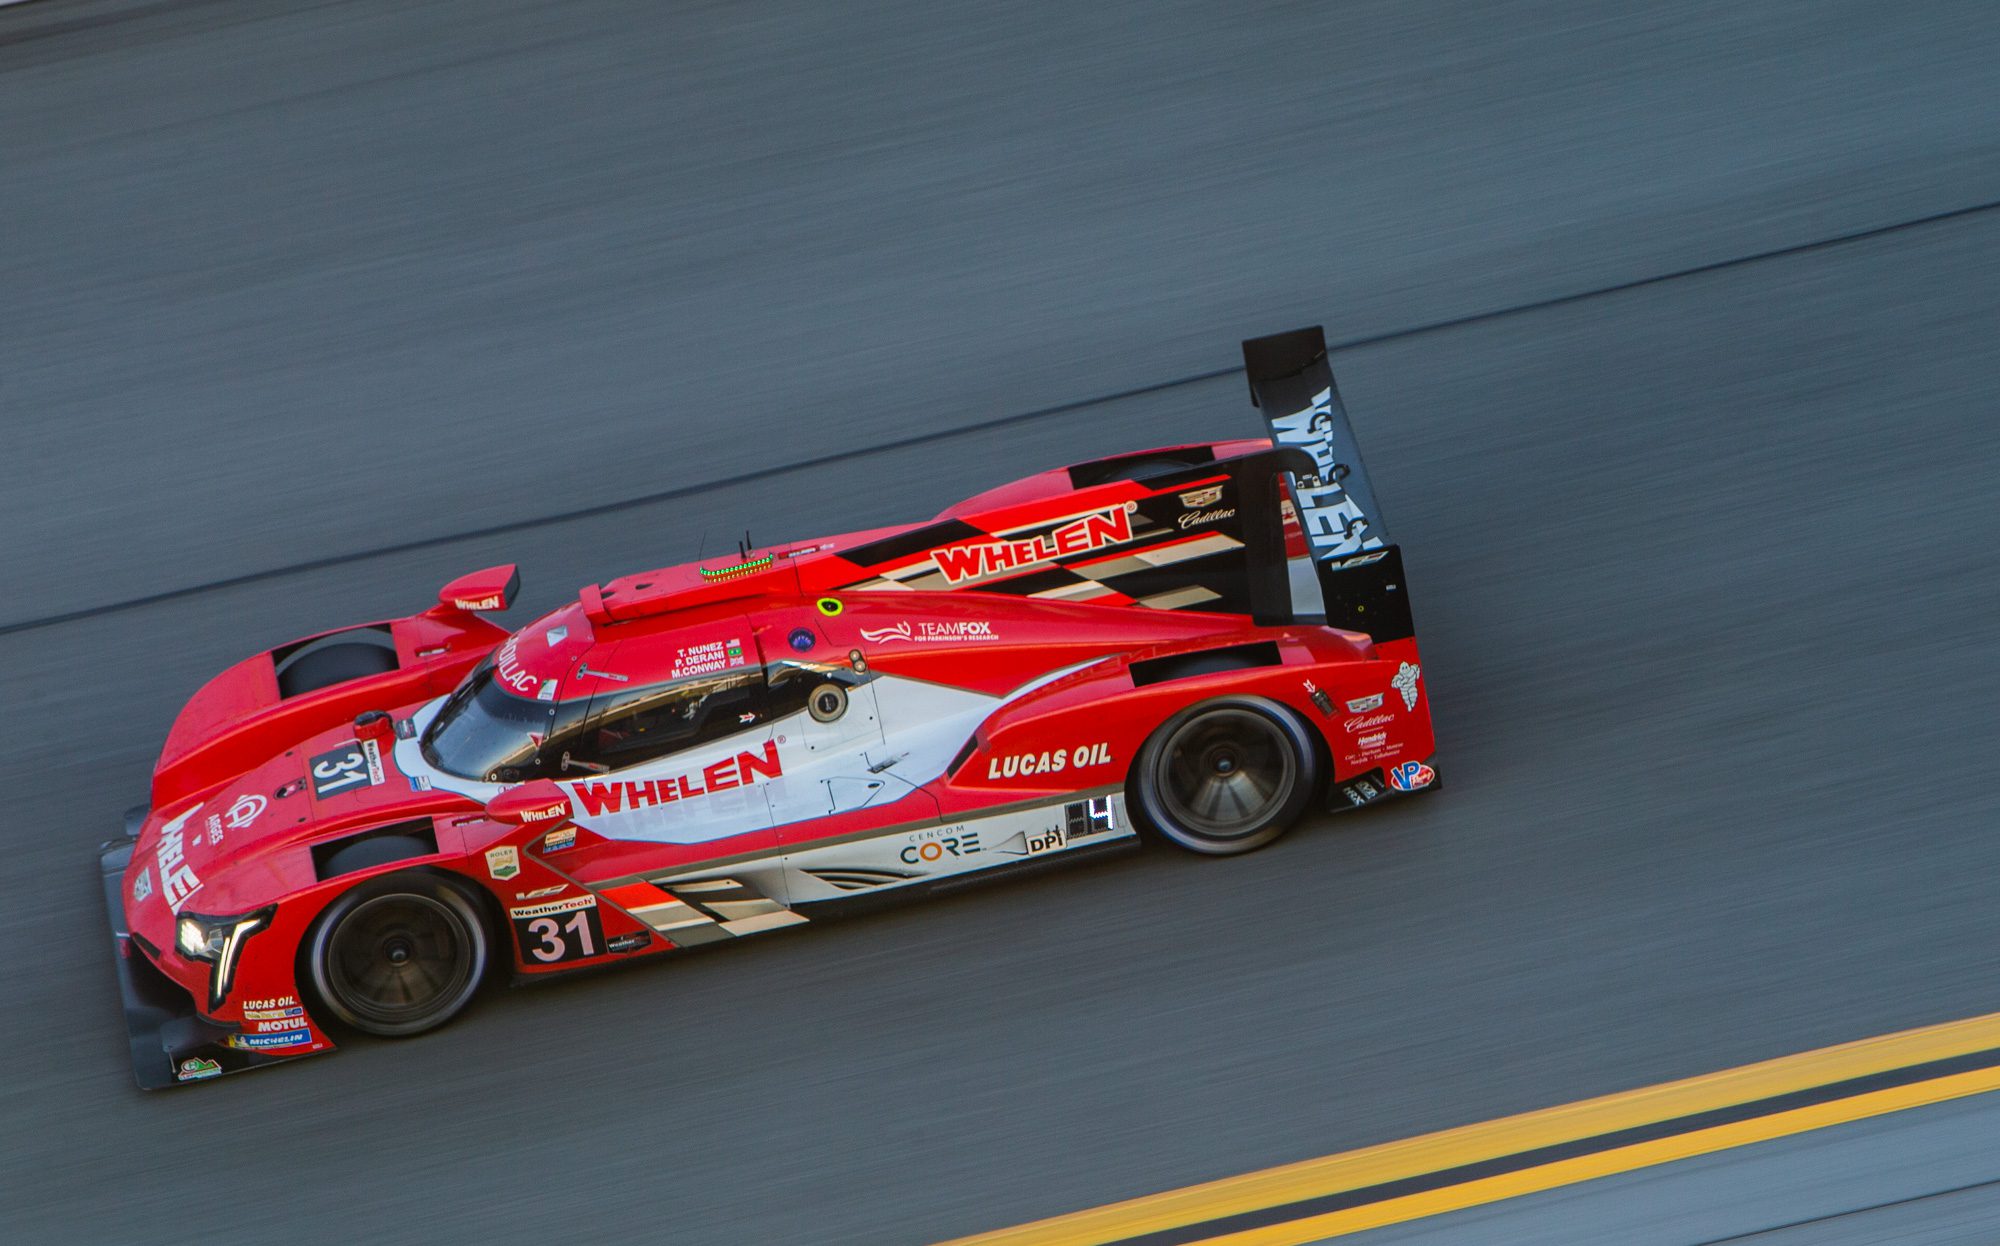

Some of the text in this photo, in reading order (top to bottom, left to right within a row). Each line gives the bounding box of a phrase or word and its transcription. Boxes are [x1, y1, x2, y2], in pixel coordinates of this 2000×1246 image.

[1178, 508, 1236, 530] Cadillac
[929, 504, 1135, 585] WHELEN
[455, 596, 500, 610] WHELEN
[674, 650, 725, 668] P. DERANI
[677, 641, 724, 658] T. NUNEZ
[988, 742, 1112, 780] LUCAS OIL
[313, 753, 368, 793] 31
[572, 739, 782, 817] WHELEN
[1391, 760, 1420, 790] VP
[520, 803, 566, 823] WHELEN
[1088, 795, 1114, 830] 4
[909, 825, 965, 842] CENCOM
[489, 849, 513, 858] ROLEX
[900, 832, 981, 865] CORE
[513, 898, 593, 916] WeatherTech
[528, 910, 594, 963] 31
[243, 996, 295, 1009] LUCAS OIL
[258, 1018, 307, 1032] MOTUL
[249, 1034, 303, 1045] MICHELIN
